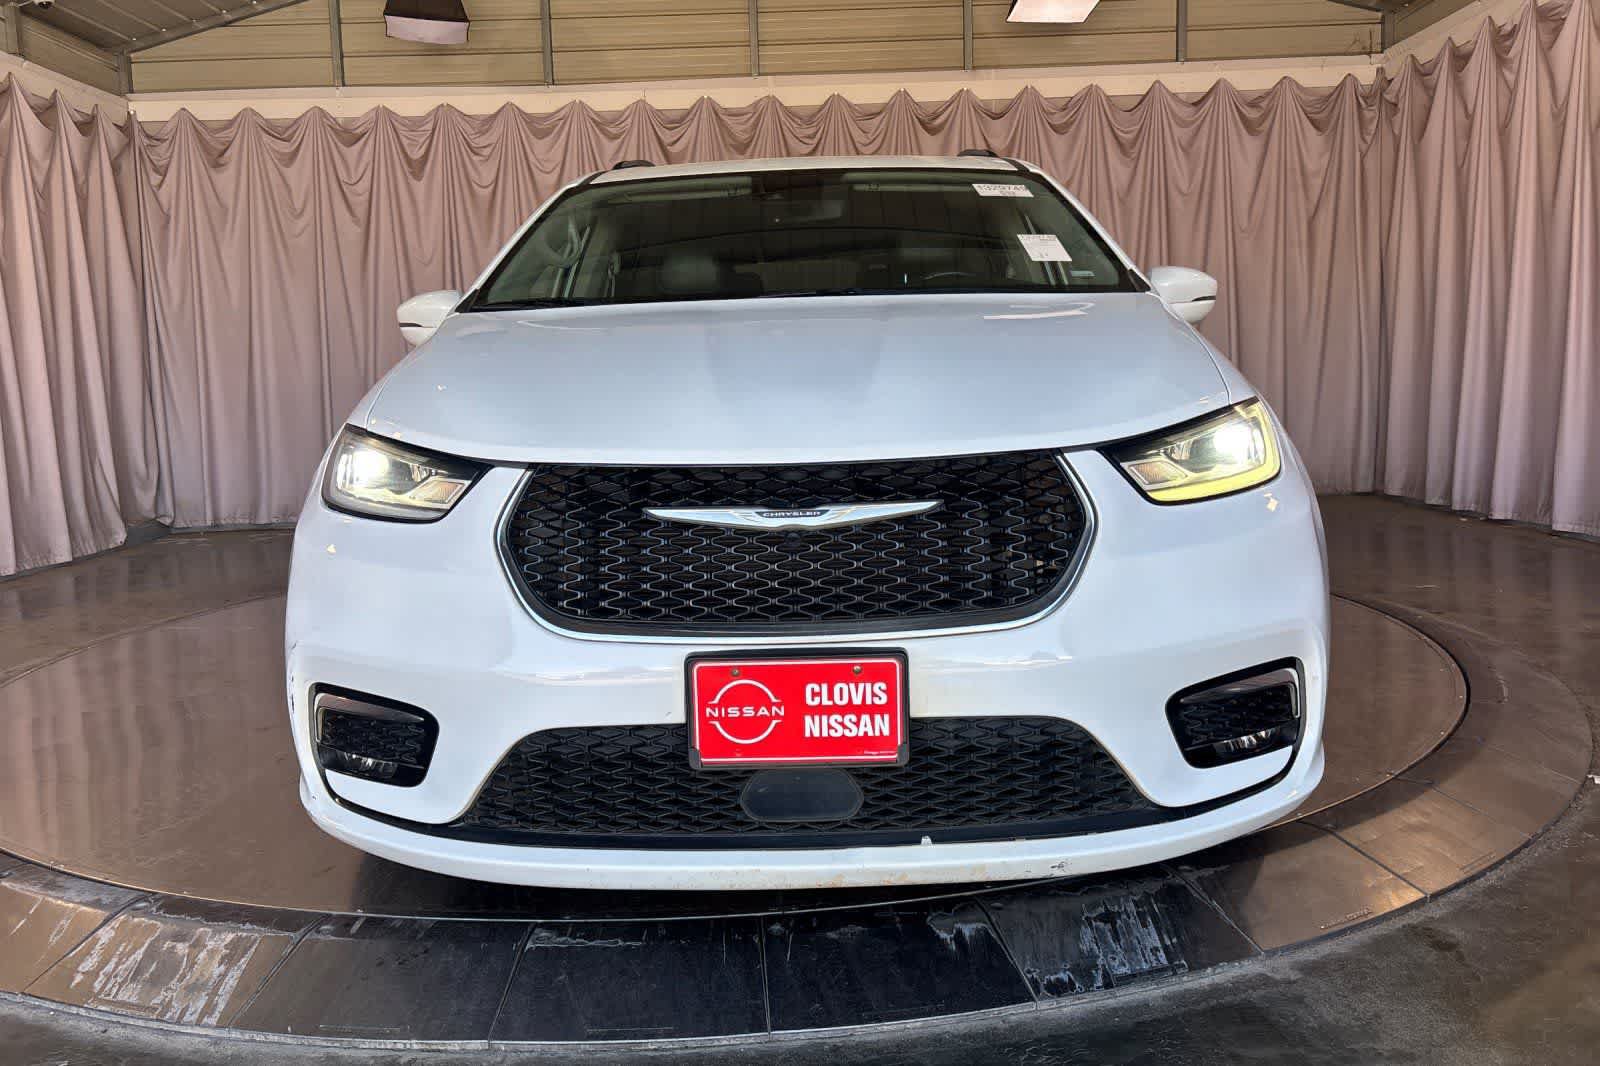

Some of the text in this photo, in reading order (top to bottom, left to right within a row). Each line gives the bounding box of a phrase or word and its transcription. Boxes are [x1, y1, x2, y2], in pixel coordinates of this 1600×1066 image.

[805, 682, 887, 706] CLOVIS
[706, 705, 784, 718] NISSAN
[804, 714, 889, 737] NISSAN
